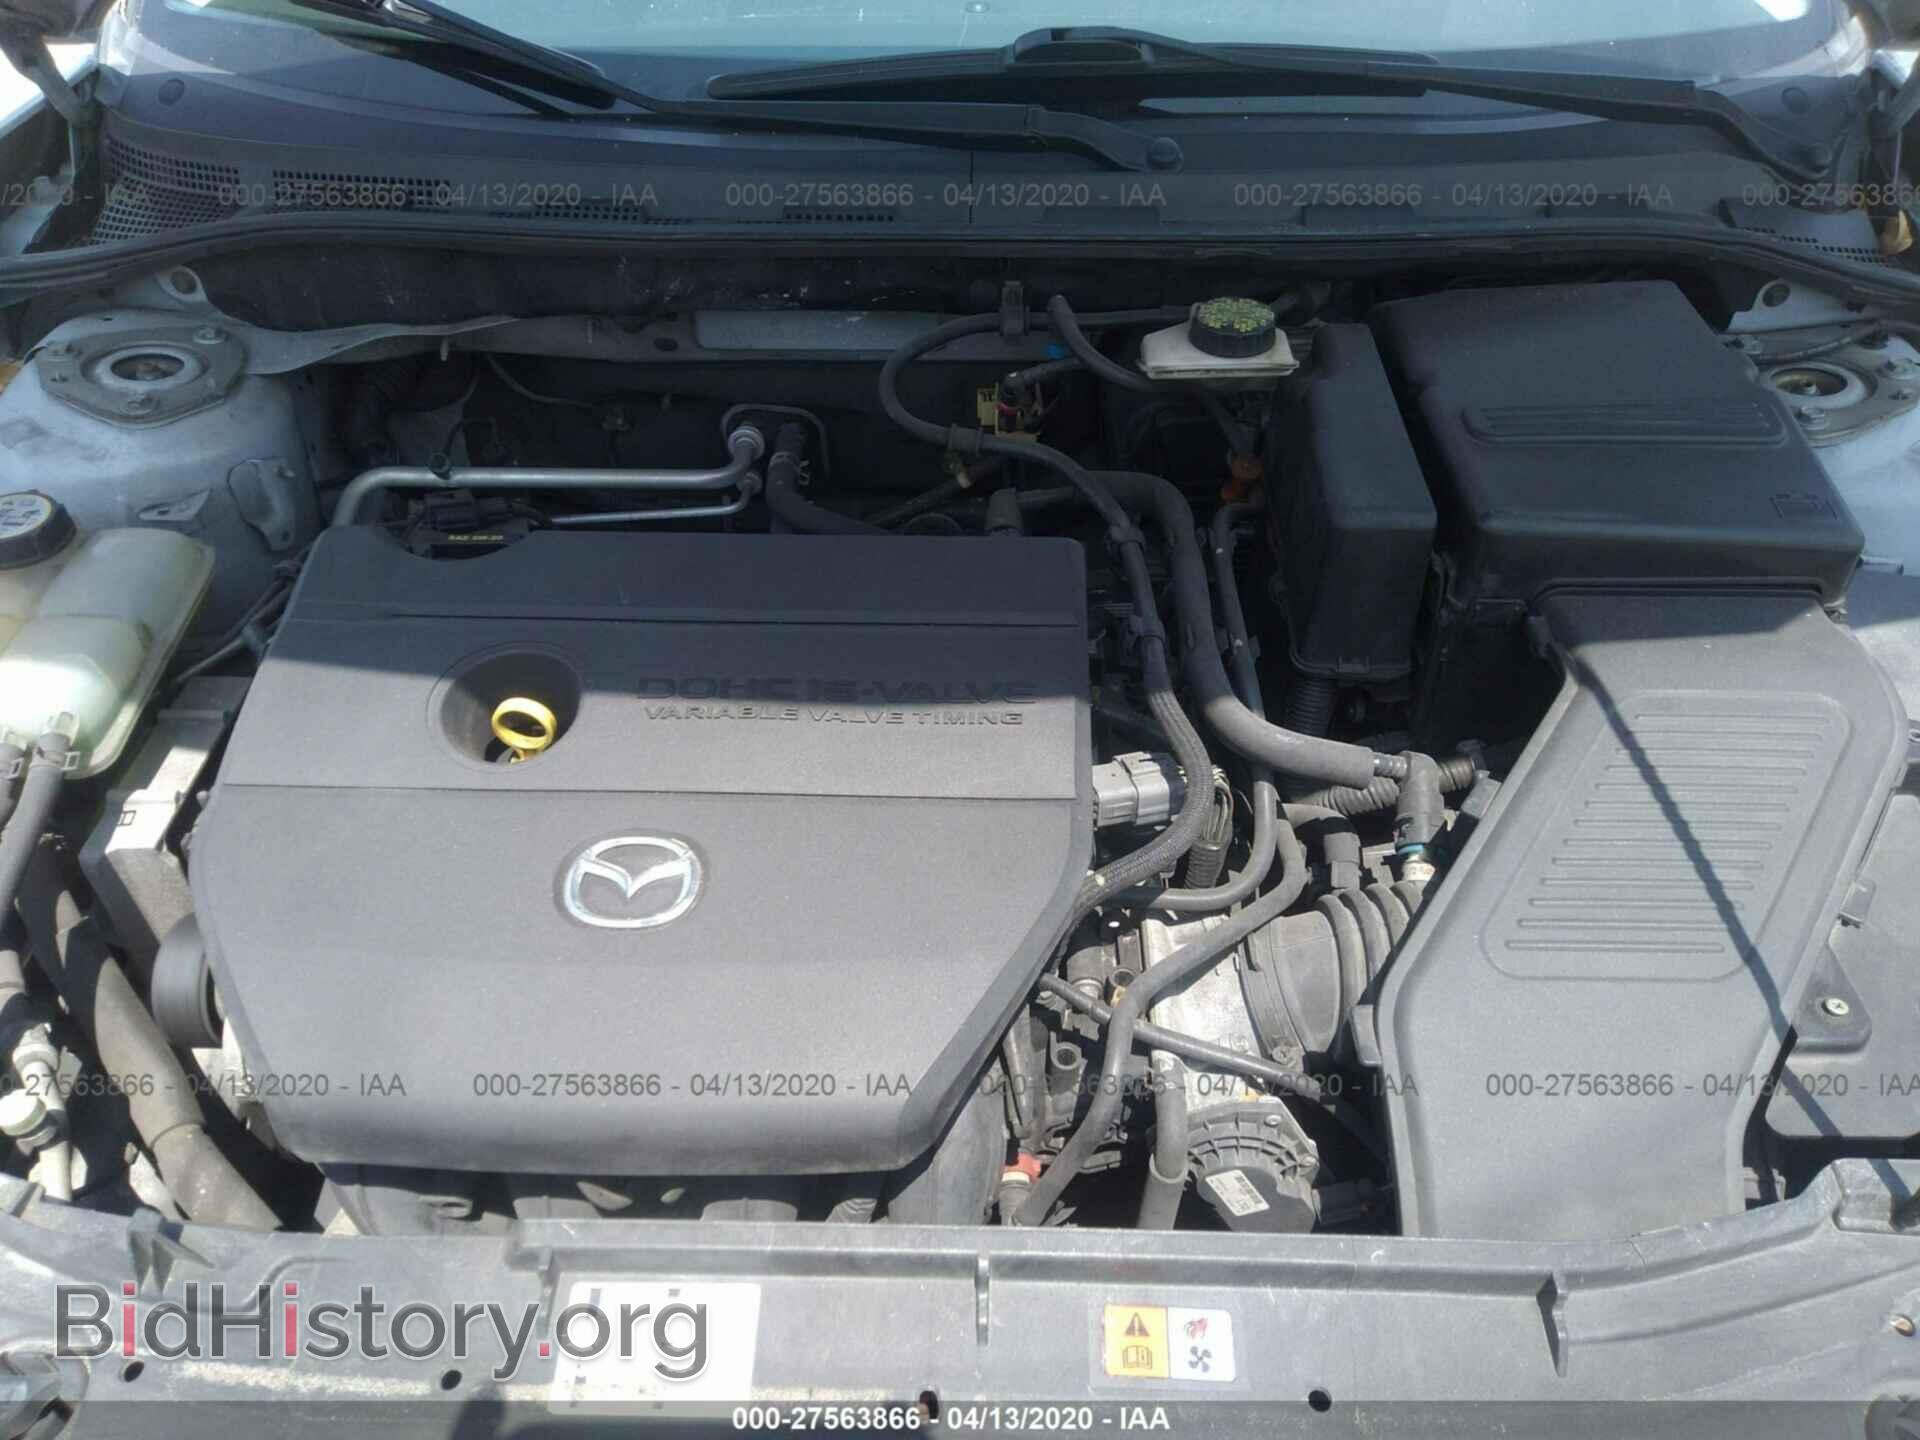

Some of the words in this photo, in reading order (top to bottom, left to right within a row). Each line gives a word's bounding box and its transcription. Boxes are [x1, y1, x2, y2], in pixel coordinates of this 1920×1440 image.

[643, 704, 799, 721] VARIABLE
[808, 707, 905, 724] VALVE
[912, 710, 1024, 726] TIMING
